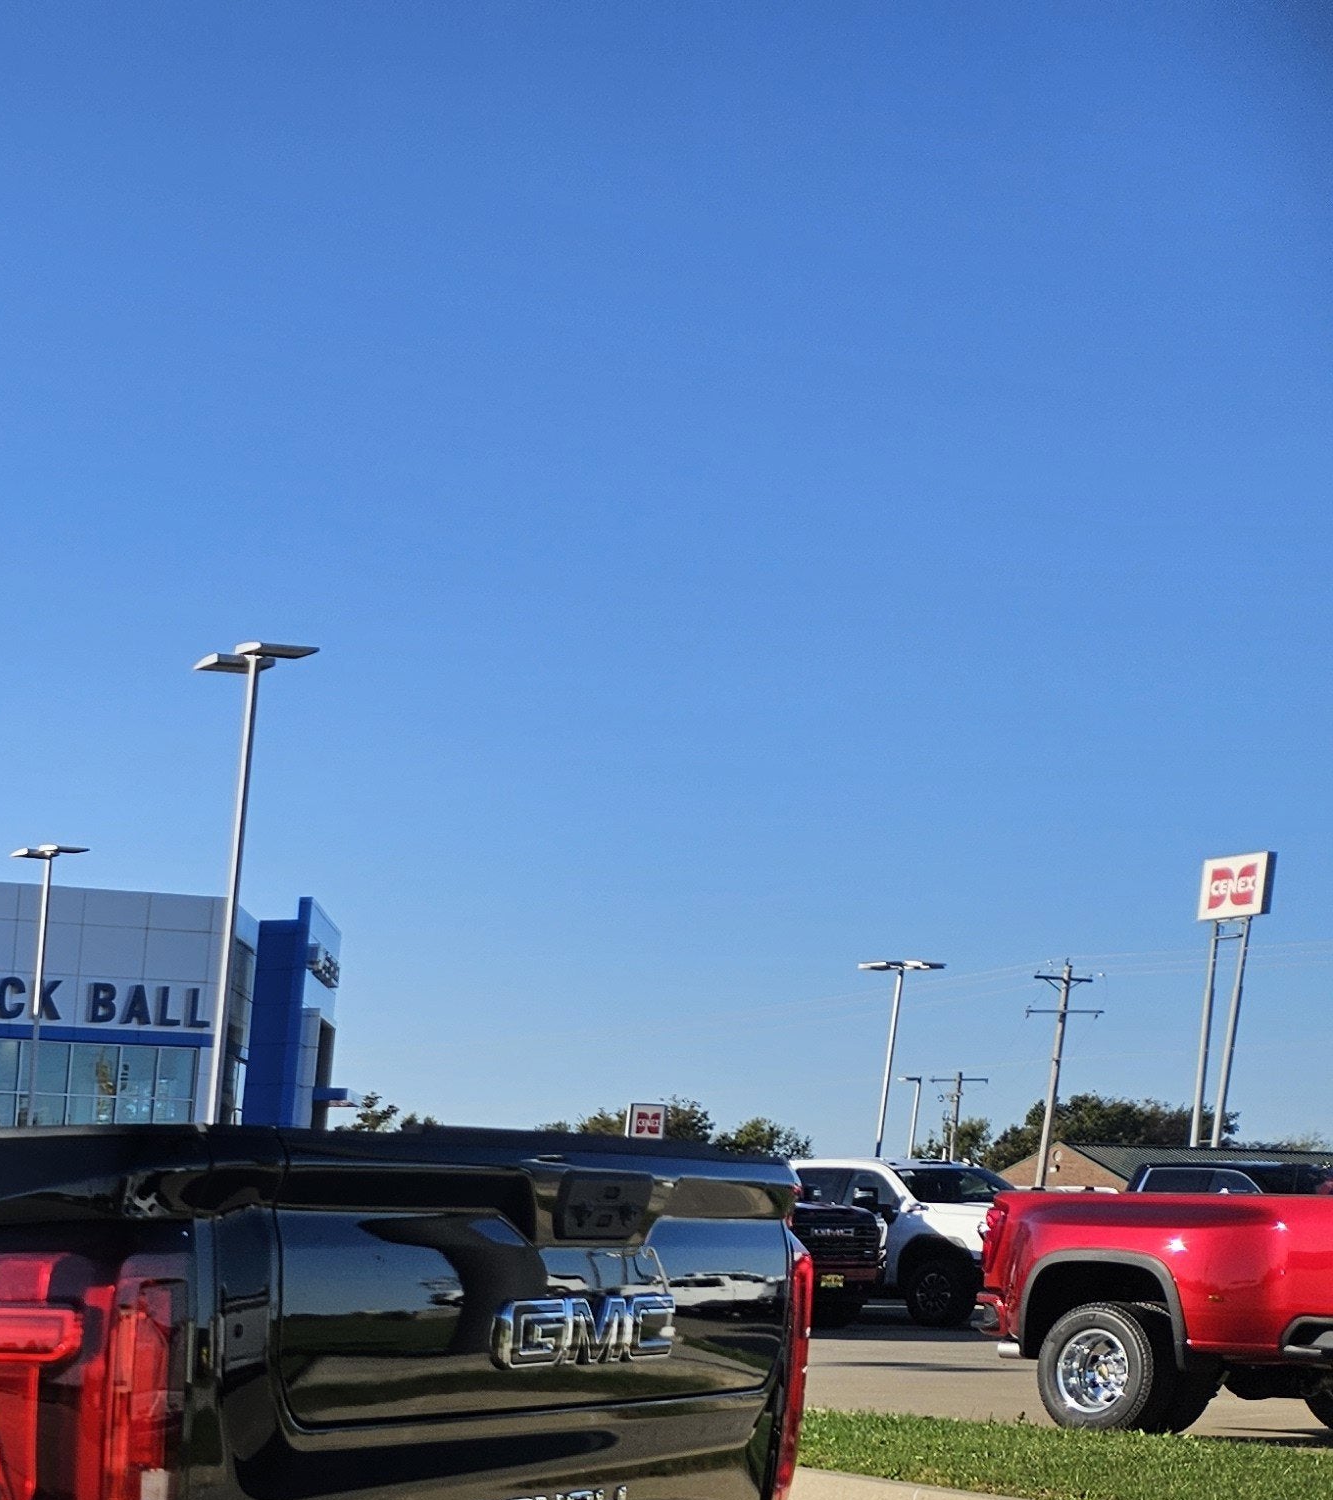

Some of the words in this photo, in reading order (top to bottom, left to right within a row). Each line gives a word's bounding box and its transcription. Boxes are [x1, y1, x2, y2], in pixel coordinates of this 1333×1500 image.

[1210, 874, 1257, 897] CENEX
[85, 982, 211, 1028] BALL
[490, 1293, 676, 1371] GMC
